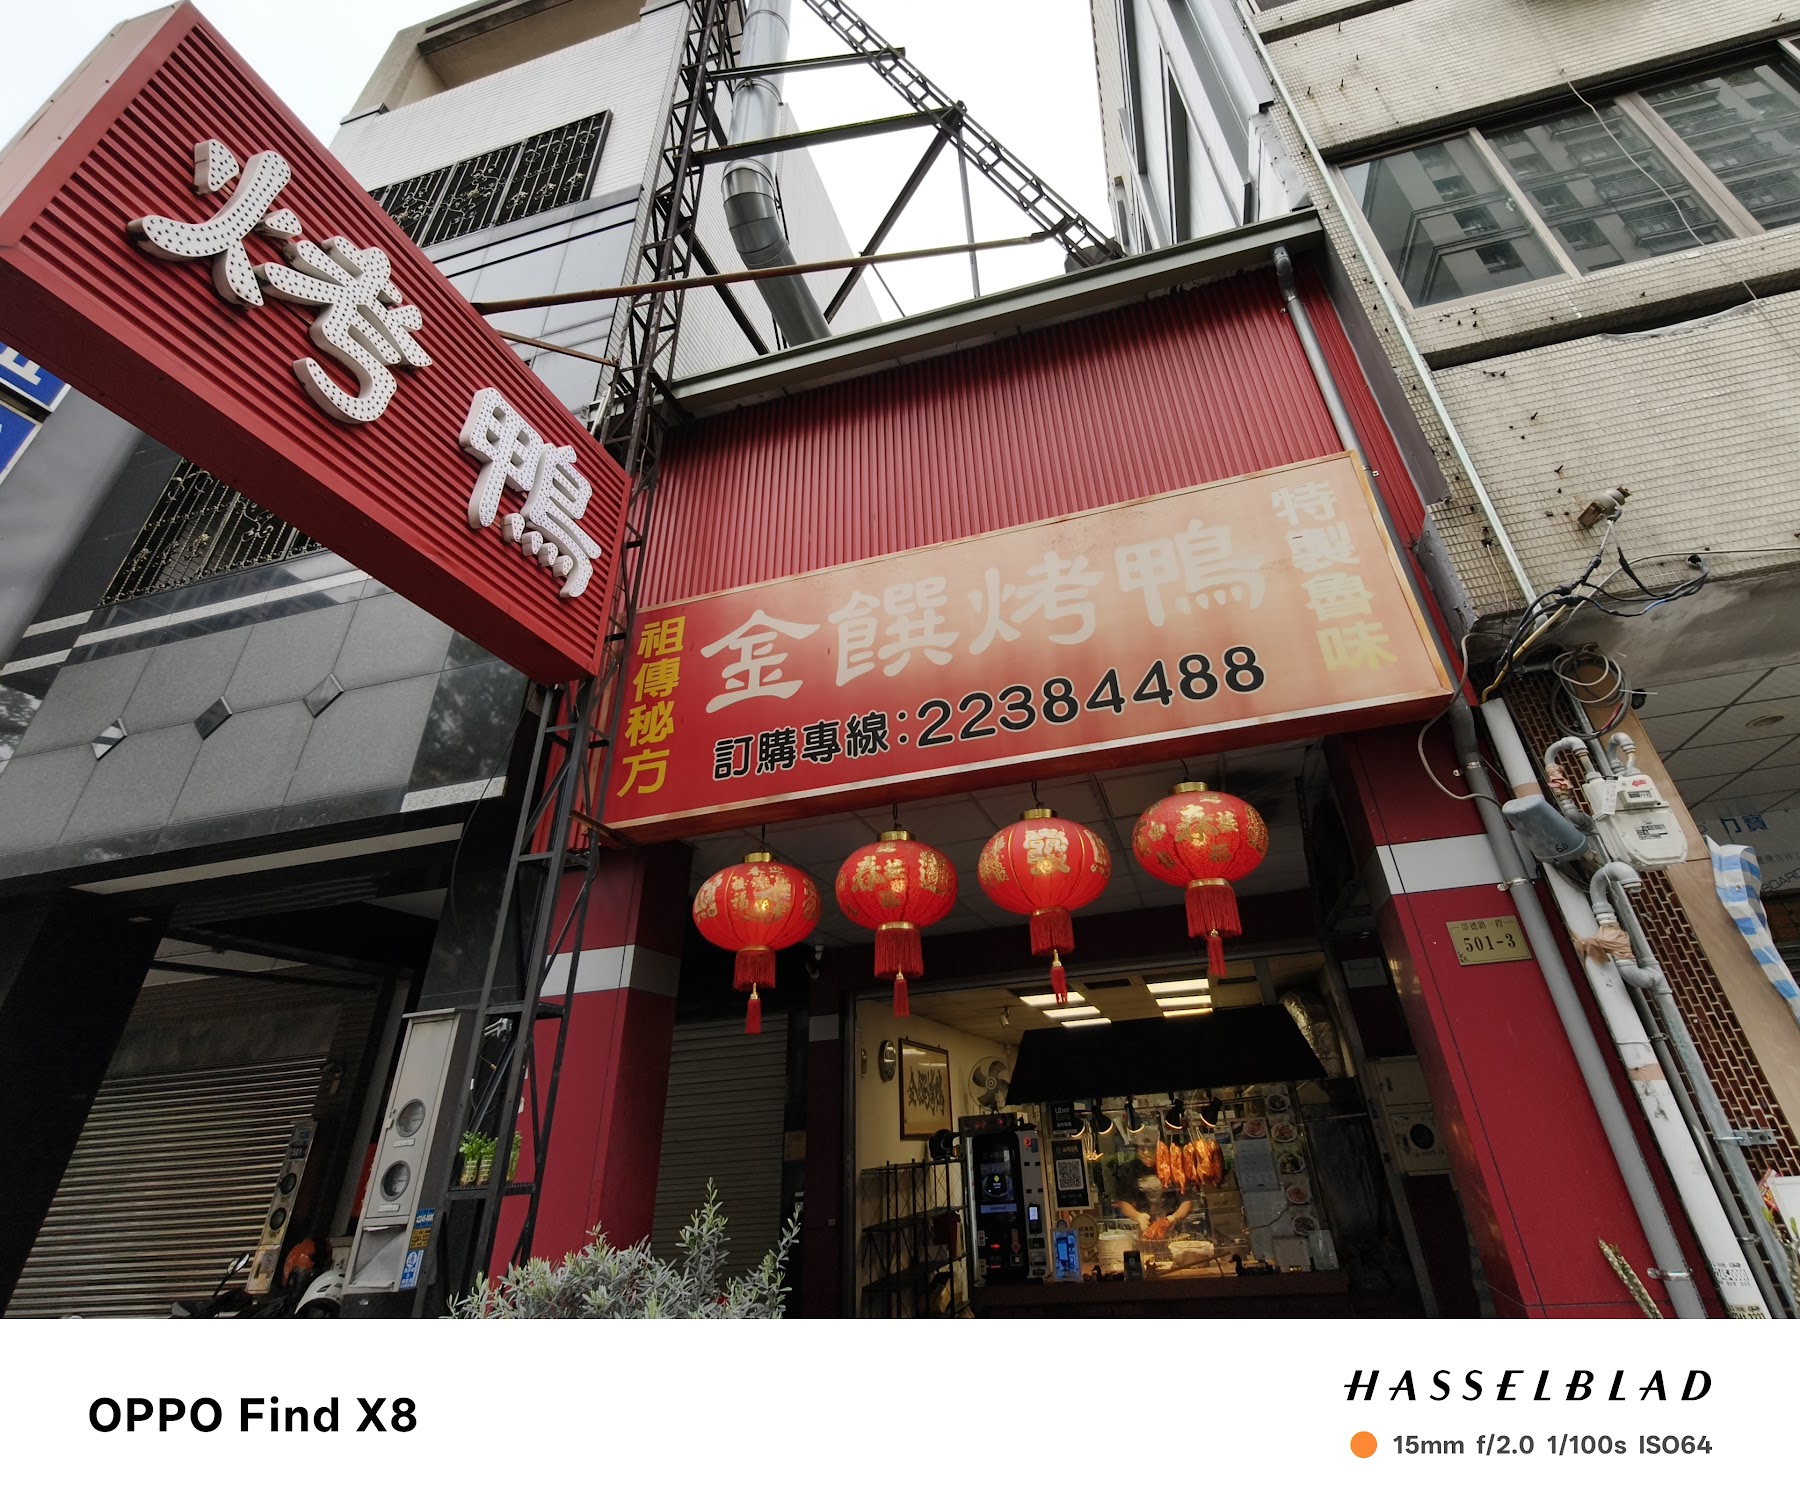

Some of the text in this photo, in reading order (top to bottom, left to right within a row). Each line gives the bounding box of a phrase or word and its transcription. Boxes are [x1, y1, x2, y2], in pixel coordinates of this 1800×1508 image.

[700, 517, 1266, 714] 金饌烤鴨
[616, 615, 686, 798] 祖傳秘方
[1555, 842, 1569, 853] 60
[1463, 933, 1517, 953] 501-3
[1054, 1106, 1070, 1114] Uber
